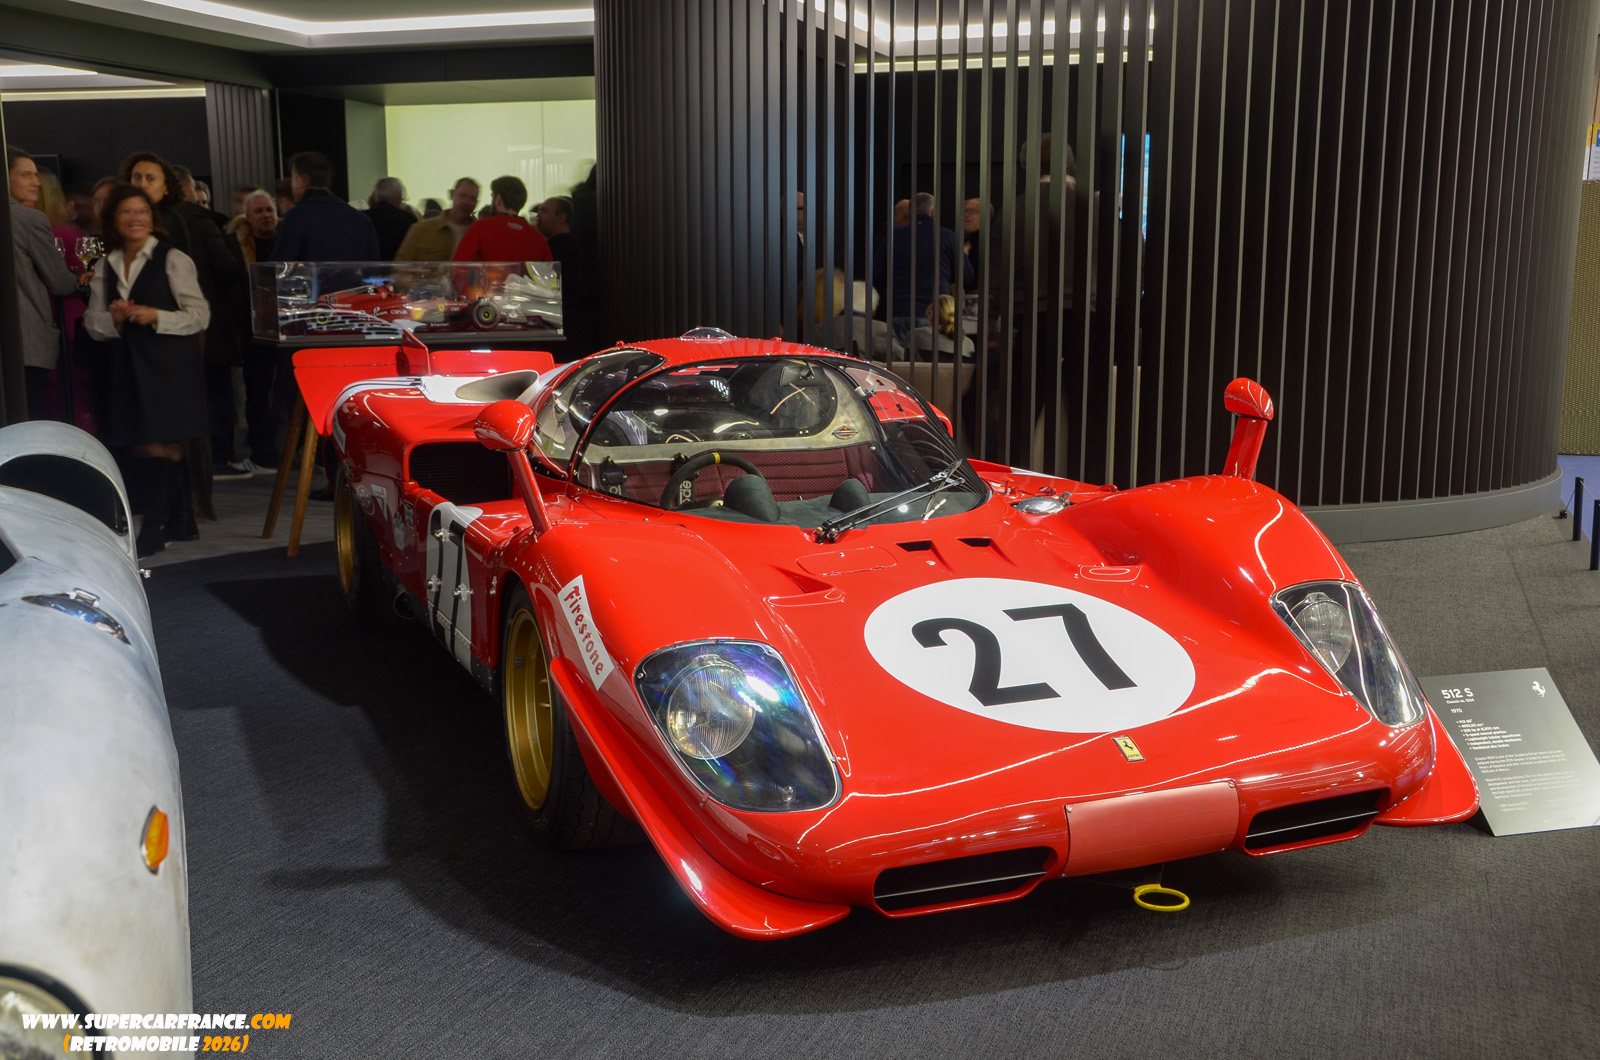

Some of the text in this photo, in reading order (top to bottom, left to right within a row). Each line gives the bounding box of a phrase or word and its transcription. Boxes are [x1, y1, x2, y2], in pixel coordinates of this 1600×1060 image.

[563, 585, 604, 676] Firestone
[911, 603, 1137, 707] 27
[1441, 687, 1474, 699] 512 S
